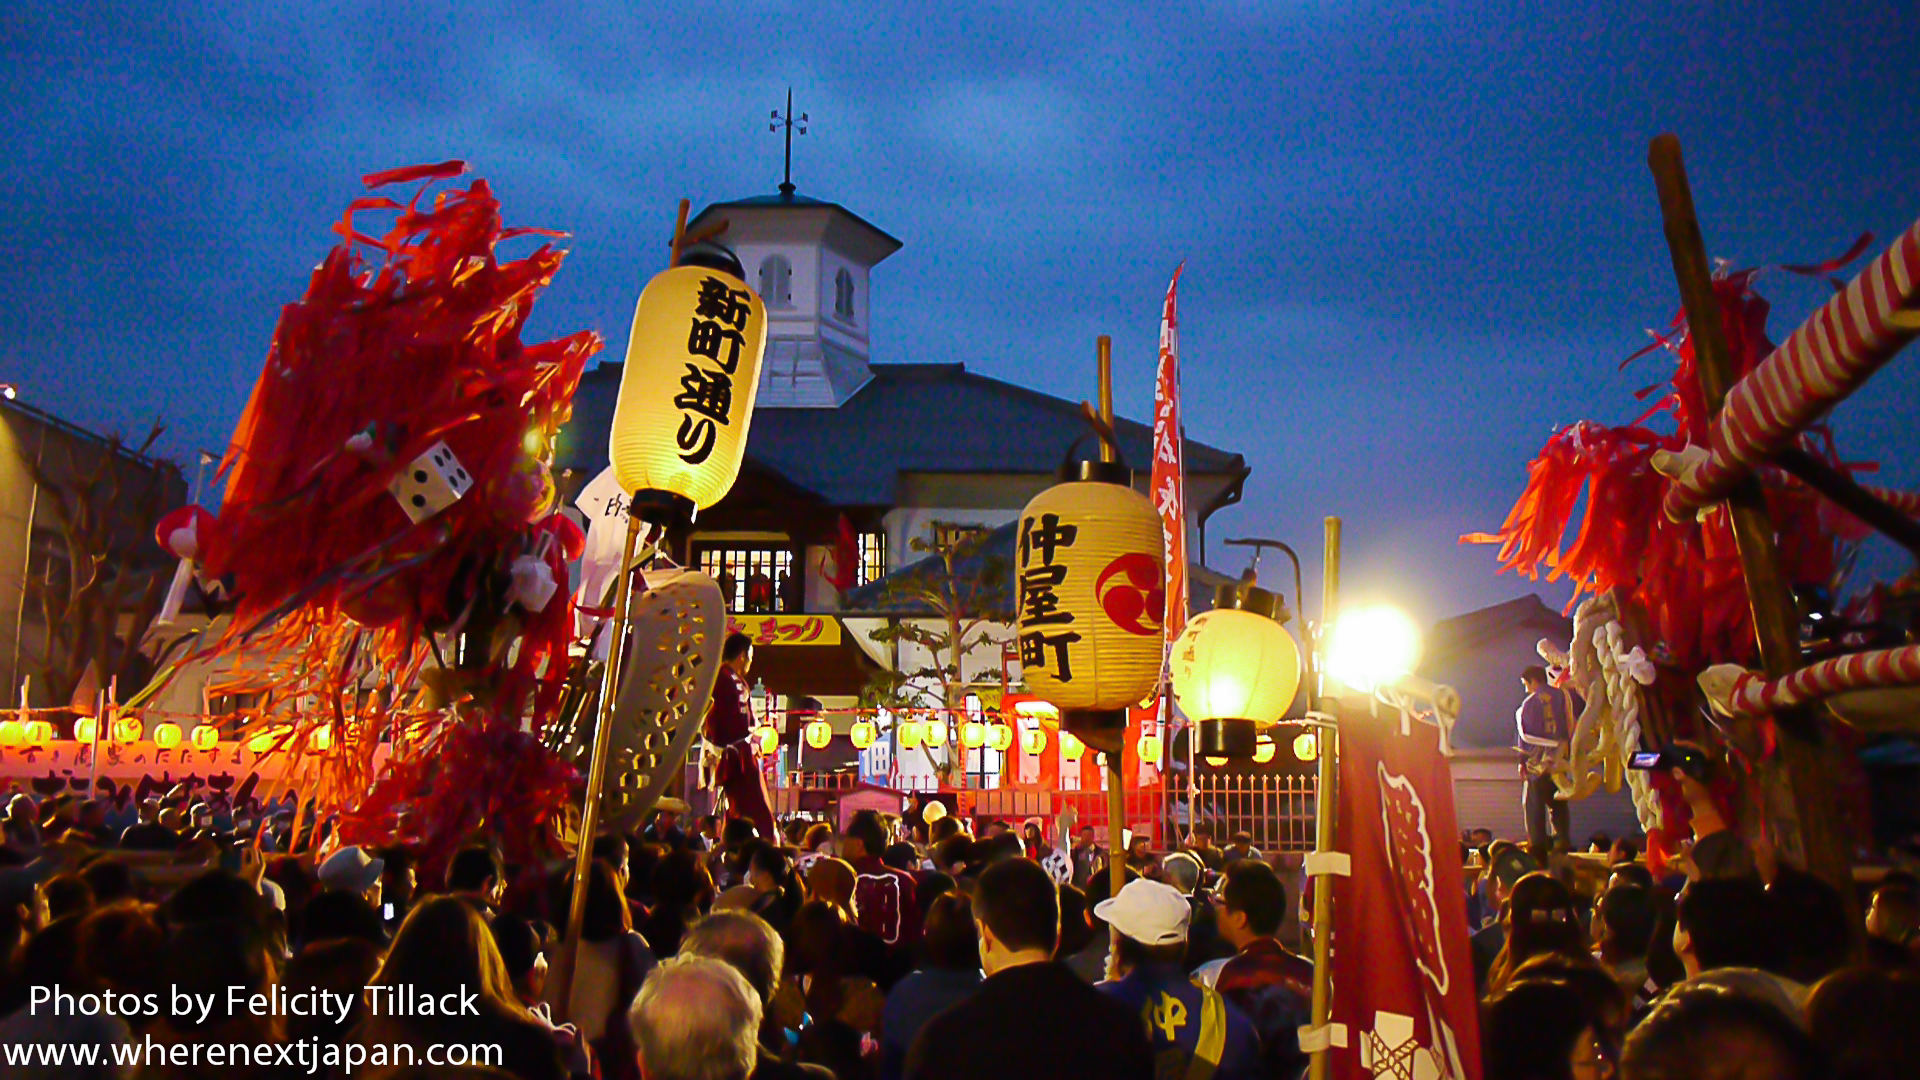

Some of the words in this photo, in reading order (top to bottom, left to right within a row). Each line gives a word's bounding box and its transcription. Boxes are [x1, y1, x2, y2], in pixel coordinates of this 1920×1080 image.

[674, 276, 751, 465] 新町通り
[1017, 513, 1082, 682] 仲屋町
